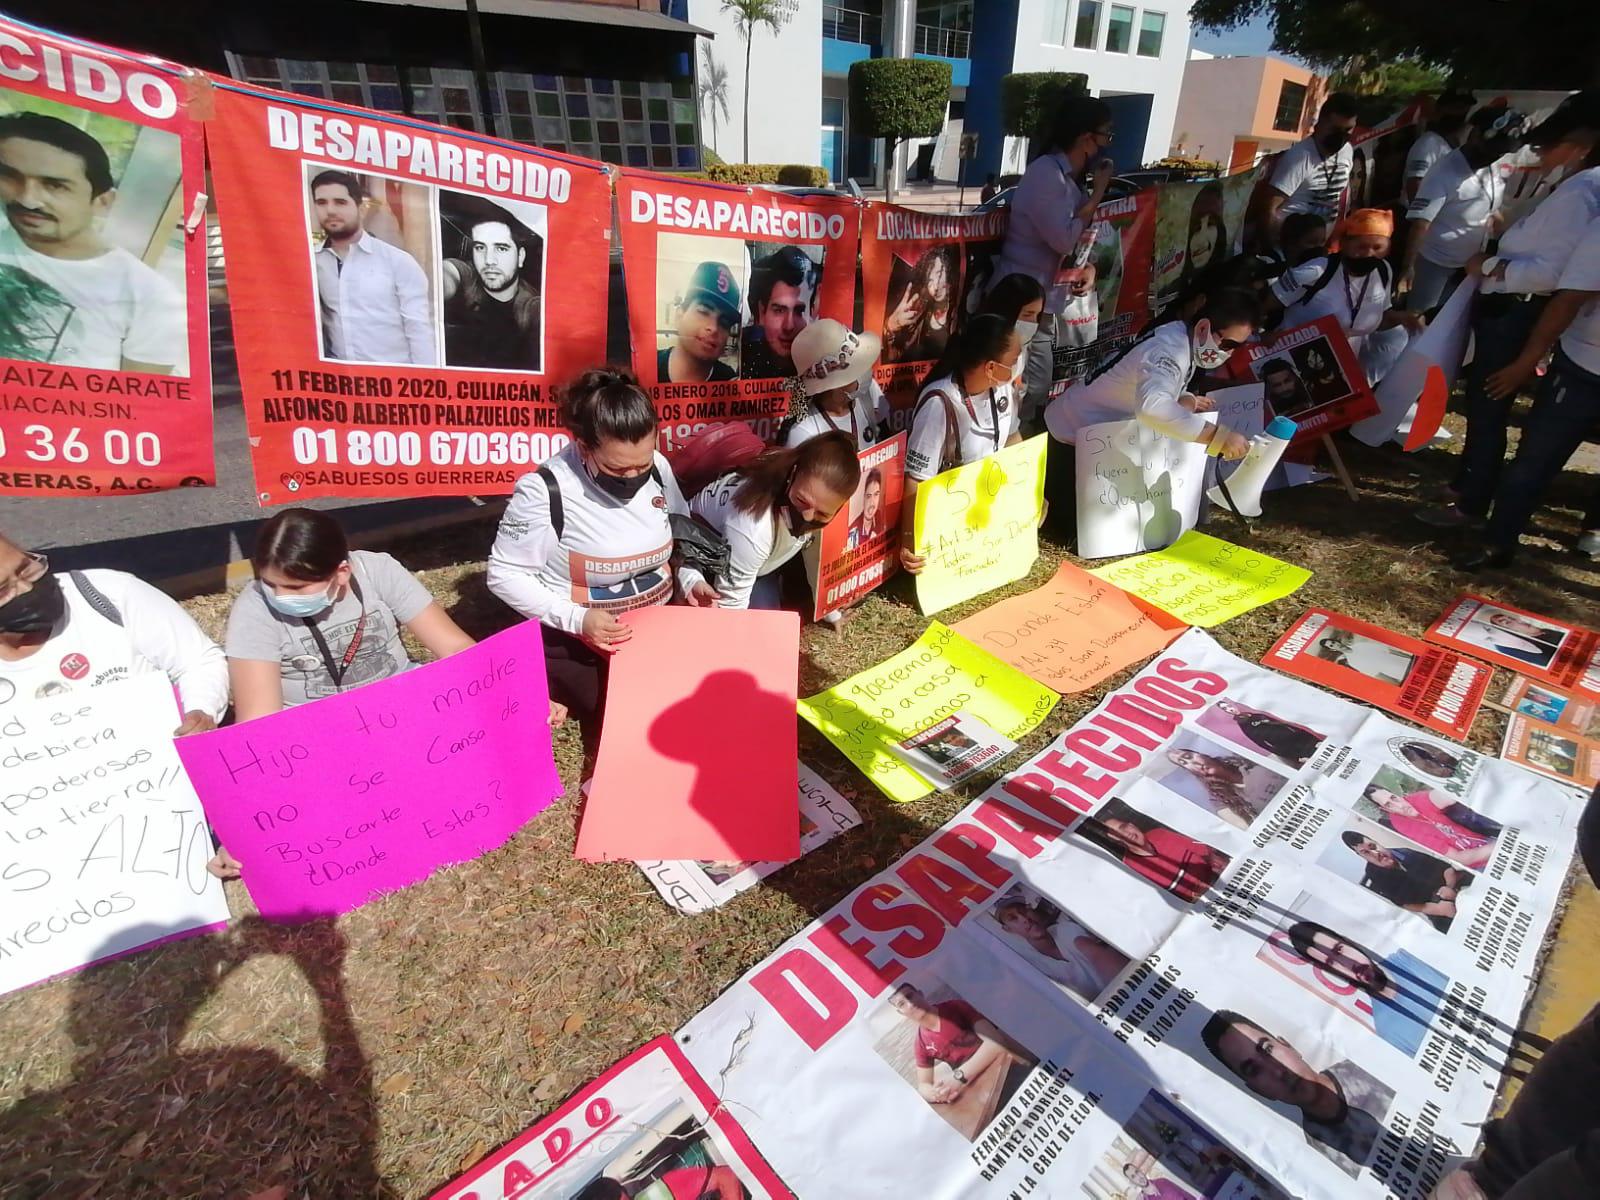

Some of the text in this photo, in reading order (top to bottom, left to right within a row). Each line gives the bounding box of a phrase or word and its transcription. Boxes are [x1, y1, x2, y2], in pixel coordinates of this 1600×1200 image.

[267, 106, 571, 204] DESAPARECIDO
[630, 190, 845, 240] DESAPARECIDO
[877, 212, 960, 240] LOCALIZADO
[0, 393, 137, 421] IACAN.SIN.
[86, 374, 192, 401] GARATE
[272, 370, 294, 391] 11
[299, 370, 393, 398] FEBRERO
[397, 378, 452, 401] 2020,
[457, 380, 545, 404] CULIACÁN,
[664, 384, 708, 400] ENERO
[264, 397, 349, 424] ALFONSO
[353, 402, 431, 426] ALBERTO
[435, 404, 530, 427] PALAZUELOS
[686, 402, 728, 421] OMAR
[730, 397, 786, 418] RAMIREZ
[24, 424, 89, 464] 36
[293, 427, 339, 465] 01
[347, 430, 422, 466] 800
[1084, 429, 1112, 455] Si
[305, 470, 409, 486] SABUESOS
[356, 705, 398, 735] tu
[432, 655, 516, 713] madre
[253, 803, 299, 832] no
[501, 699, 519, 721] de
[77, 809, 209, 896] ALTO
[750, 657, 1229, 1052] DESAPARECIDOS
[1251, 819, 1281, 849] GLORIA
[1473, 886, 1503, 928] ALBERTO
[1475, 915, 1509, 974] VALDENEGRO
[1095, 988, 1130, 1027] PEDRO
[1112, 996, 1155, 1044] ROMERO
[1142, 987, 1199, 1048] 18/10/2018.
[970, 1105, 1023, 1167] FERNANDO
[980, 1066, 1075, 1182] RAMÍREZ RODRÍGUEZ
[1017, 1093, 1075, 1165] 16/10/2019
[1018, 1090, 1105, 1195] LA CRUZ DE ELOTA.
[1380, 1110, 1412, 1153] ANGEL
